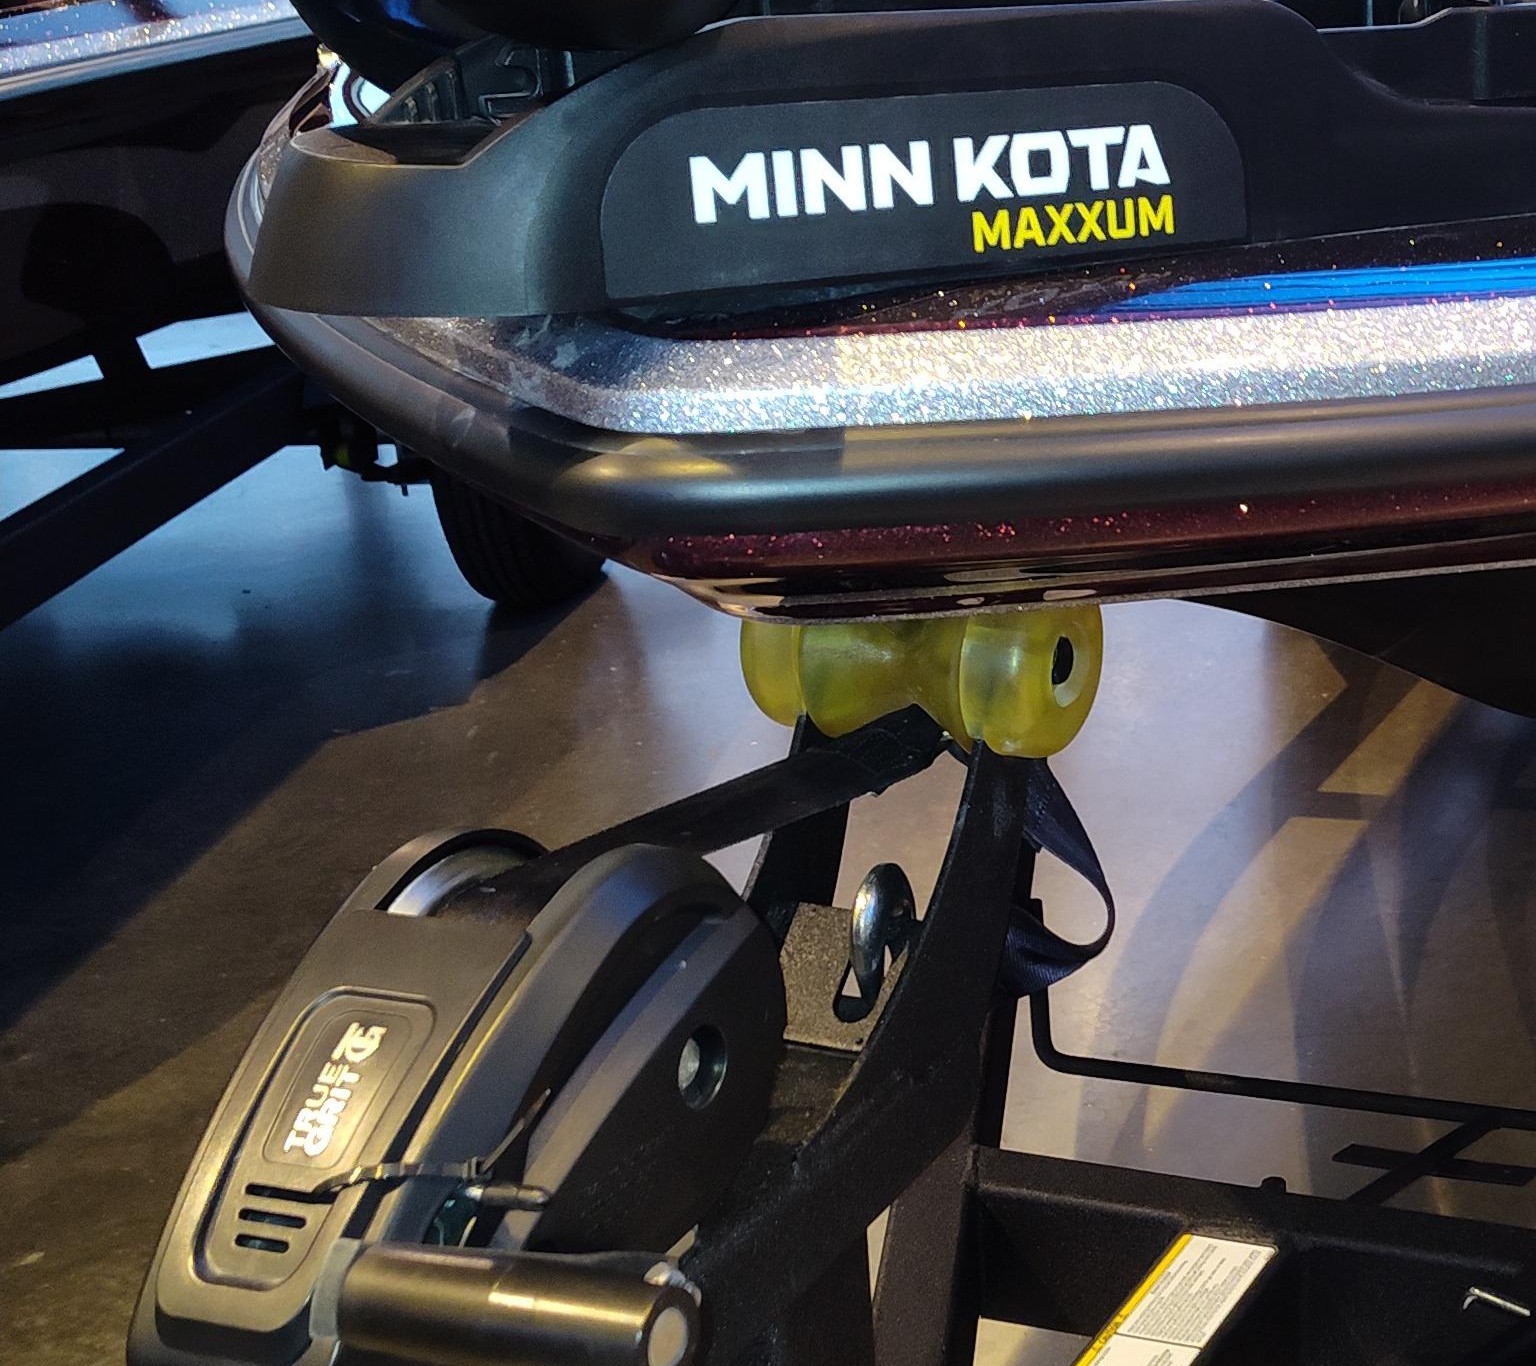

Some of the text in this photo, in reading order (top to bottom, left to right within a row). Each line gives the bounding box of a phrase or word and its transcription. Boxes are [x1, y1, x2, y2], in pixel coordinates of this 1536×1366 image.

[687, 123, 1172, 225] MINN KOTA
[971, 193, 1177, 254] MAXXUM
[283, 1061, 342, 1153] TRUE
[303, 1064, 362, 1156] GRIT
